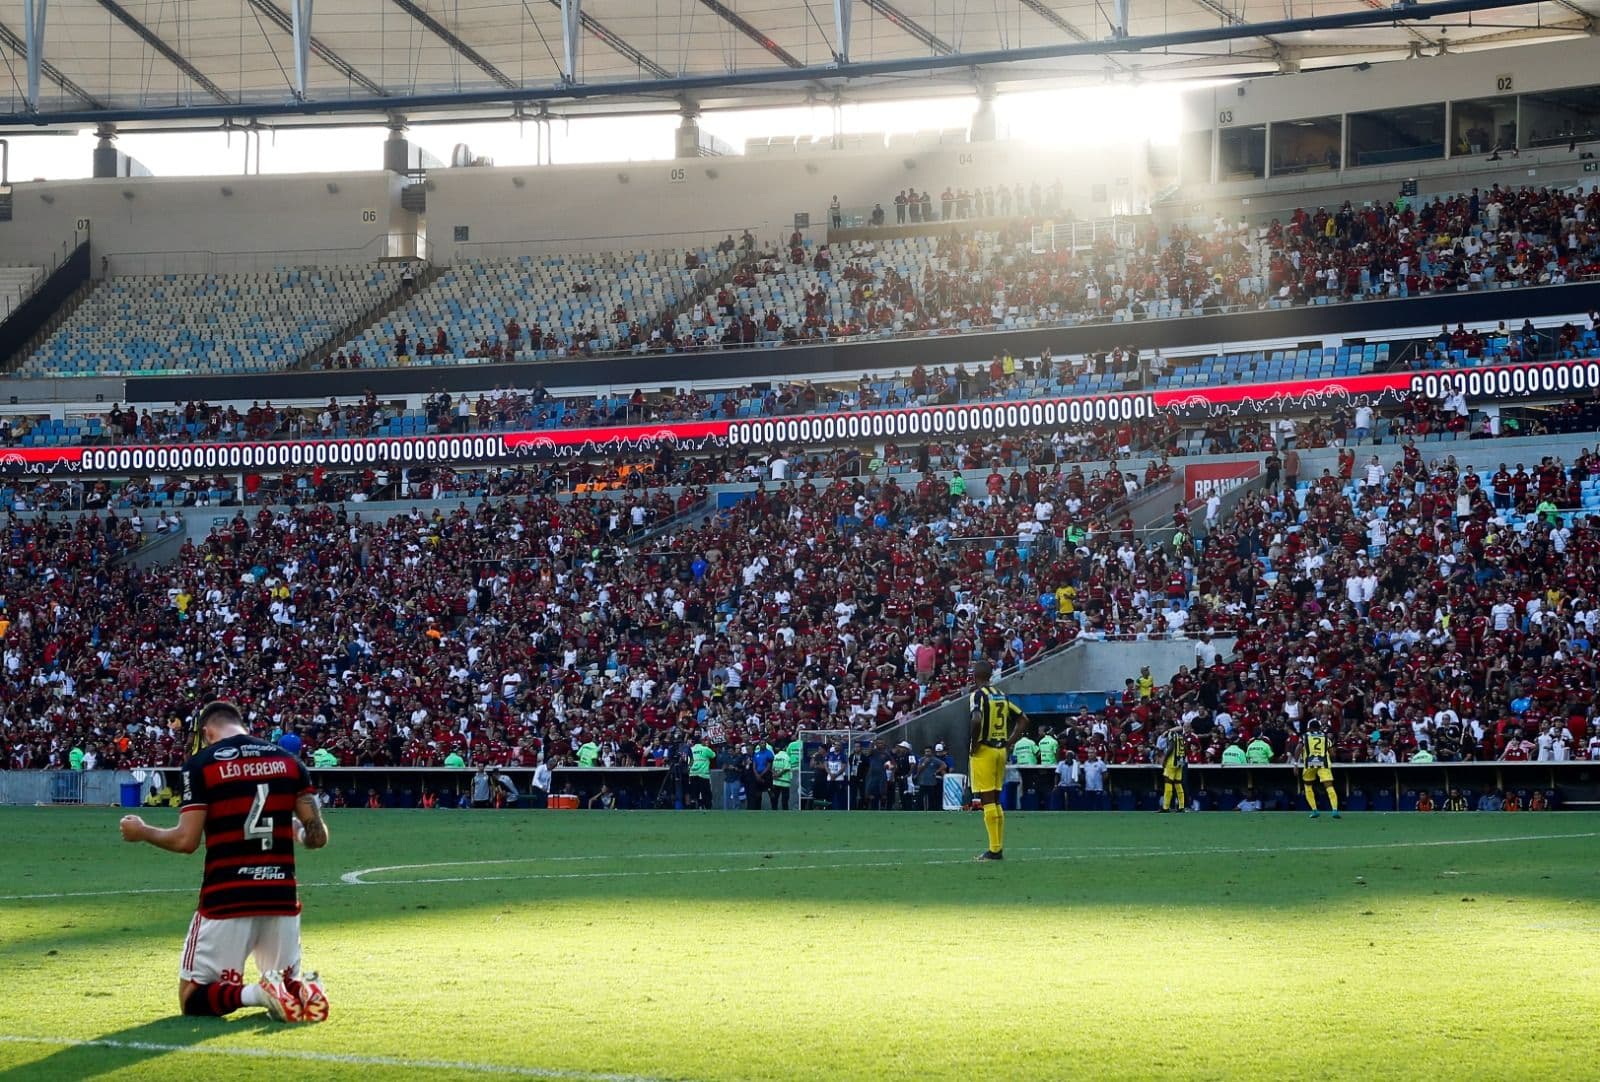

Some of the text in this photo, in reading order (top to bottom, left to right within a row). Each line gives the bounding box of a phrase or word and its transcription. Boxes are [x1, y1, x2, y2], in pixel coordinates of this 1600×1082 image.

[1497, 77, 1512, 91] 02
[1219, 110, 1233, 123] 03
[959, 153, 973, 165] 04
[671, 168, 685, 180] 05
[362, 210, 376, 222] 06
[77, 218, 90, 230] 07
[1195, 477, 1249, 499] BRAHM
[994, 702, 1005, 730] 3
[240, 744, 277, 752] mercado
[1312, 737, 1322, 750] 2
[219, 760, 287, 779] LÉO PEREIRA
[243, 783, 274, 851] 4
[237, 866, 281, 875] ASSIST
[253, 872, 286, 880] CARD
